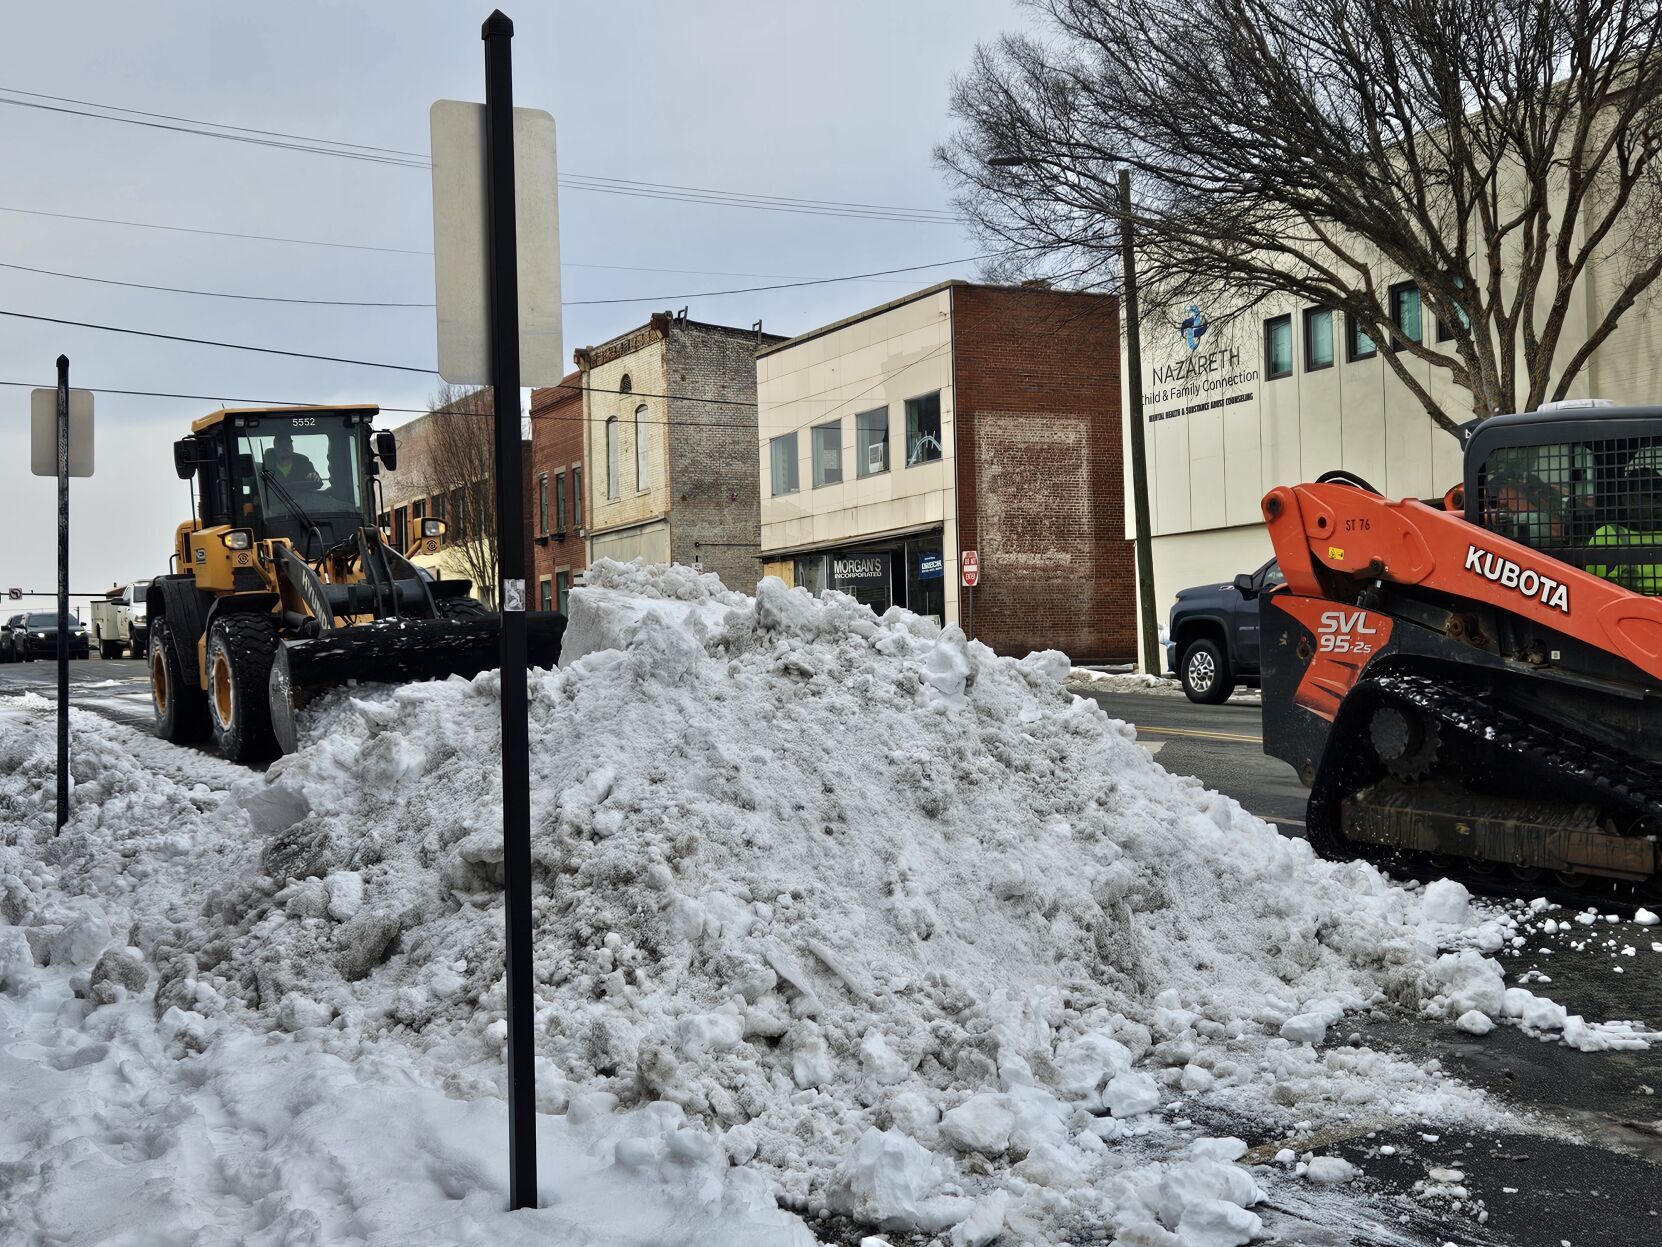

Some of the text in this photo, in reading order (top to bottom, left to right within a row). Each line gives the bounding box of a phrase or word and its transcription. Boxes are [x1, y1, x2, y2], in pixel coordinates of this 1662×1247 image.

[1153, 346, 1240, 386] NAZARETH
[1142, 370, 1259, 406] hild & Family Connection
[292, 417, 316, 427] 5552
[1345, 518, 1370, 531] ST 76
[834, 558, 881, 574] MORGAN'S
[834, 571, 882, 579] INCORPORATED
[1464, 545, 1569, 613] KUBOTA
[302, 569, 332, 630] HYUND
[1317, 611, 1377, 634] SVL
